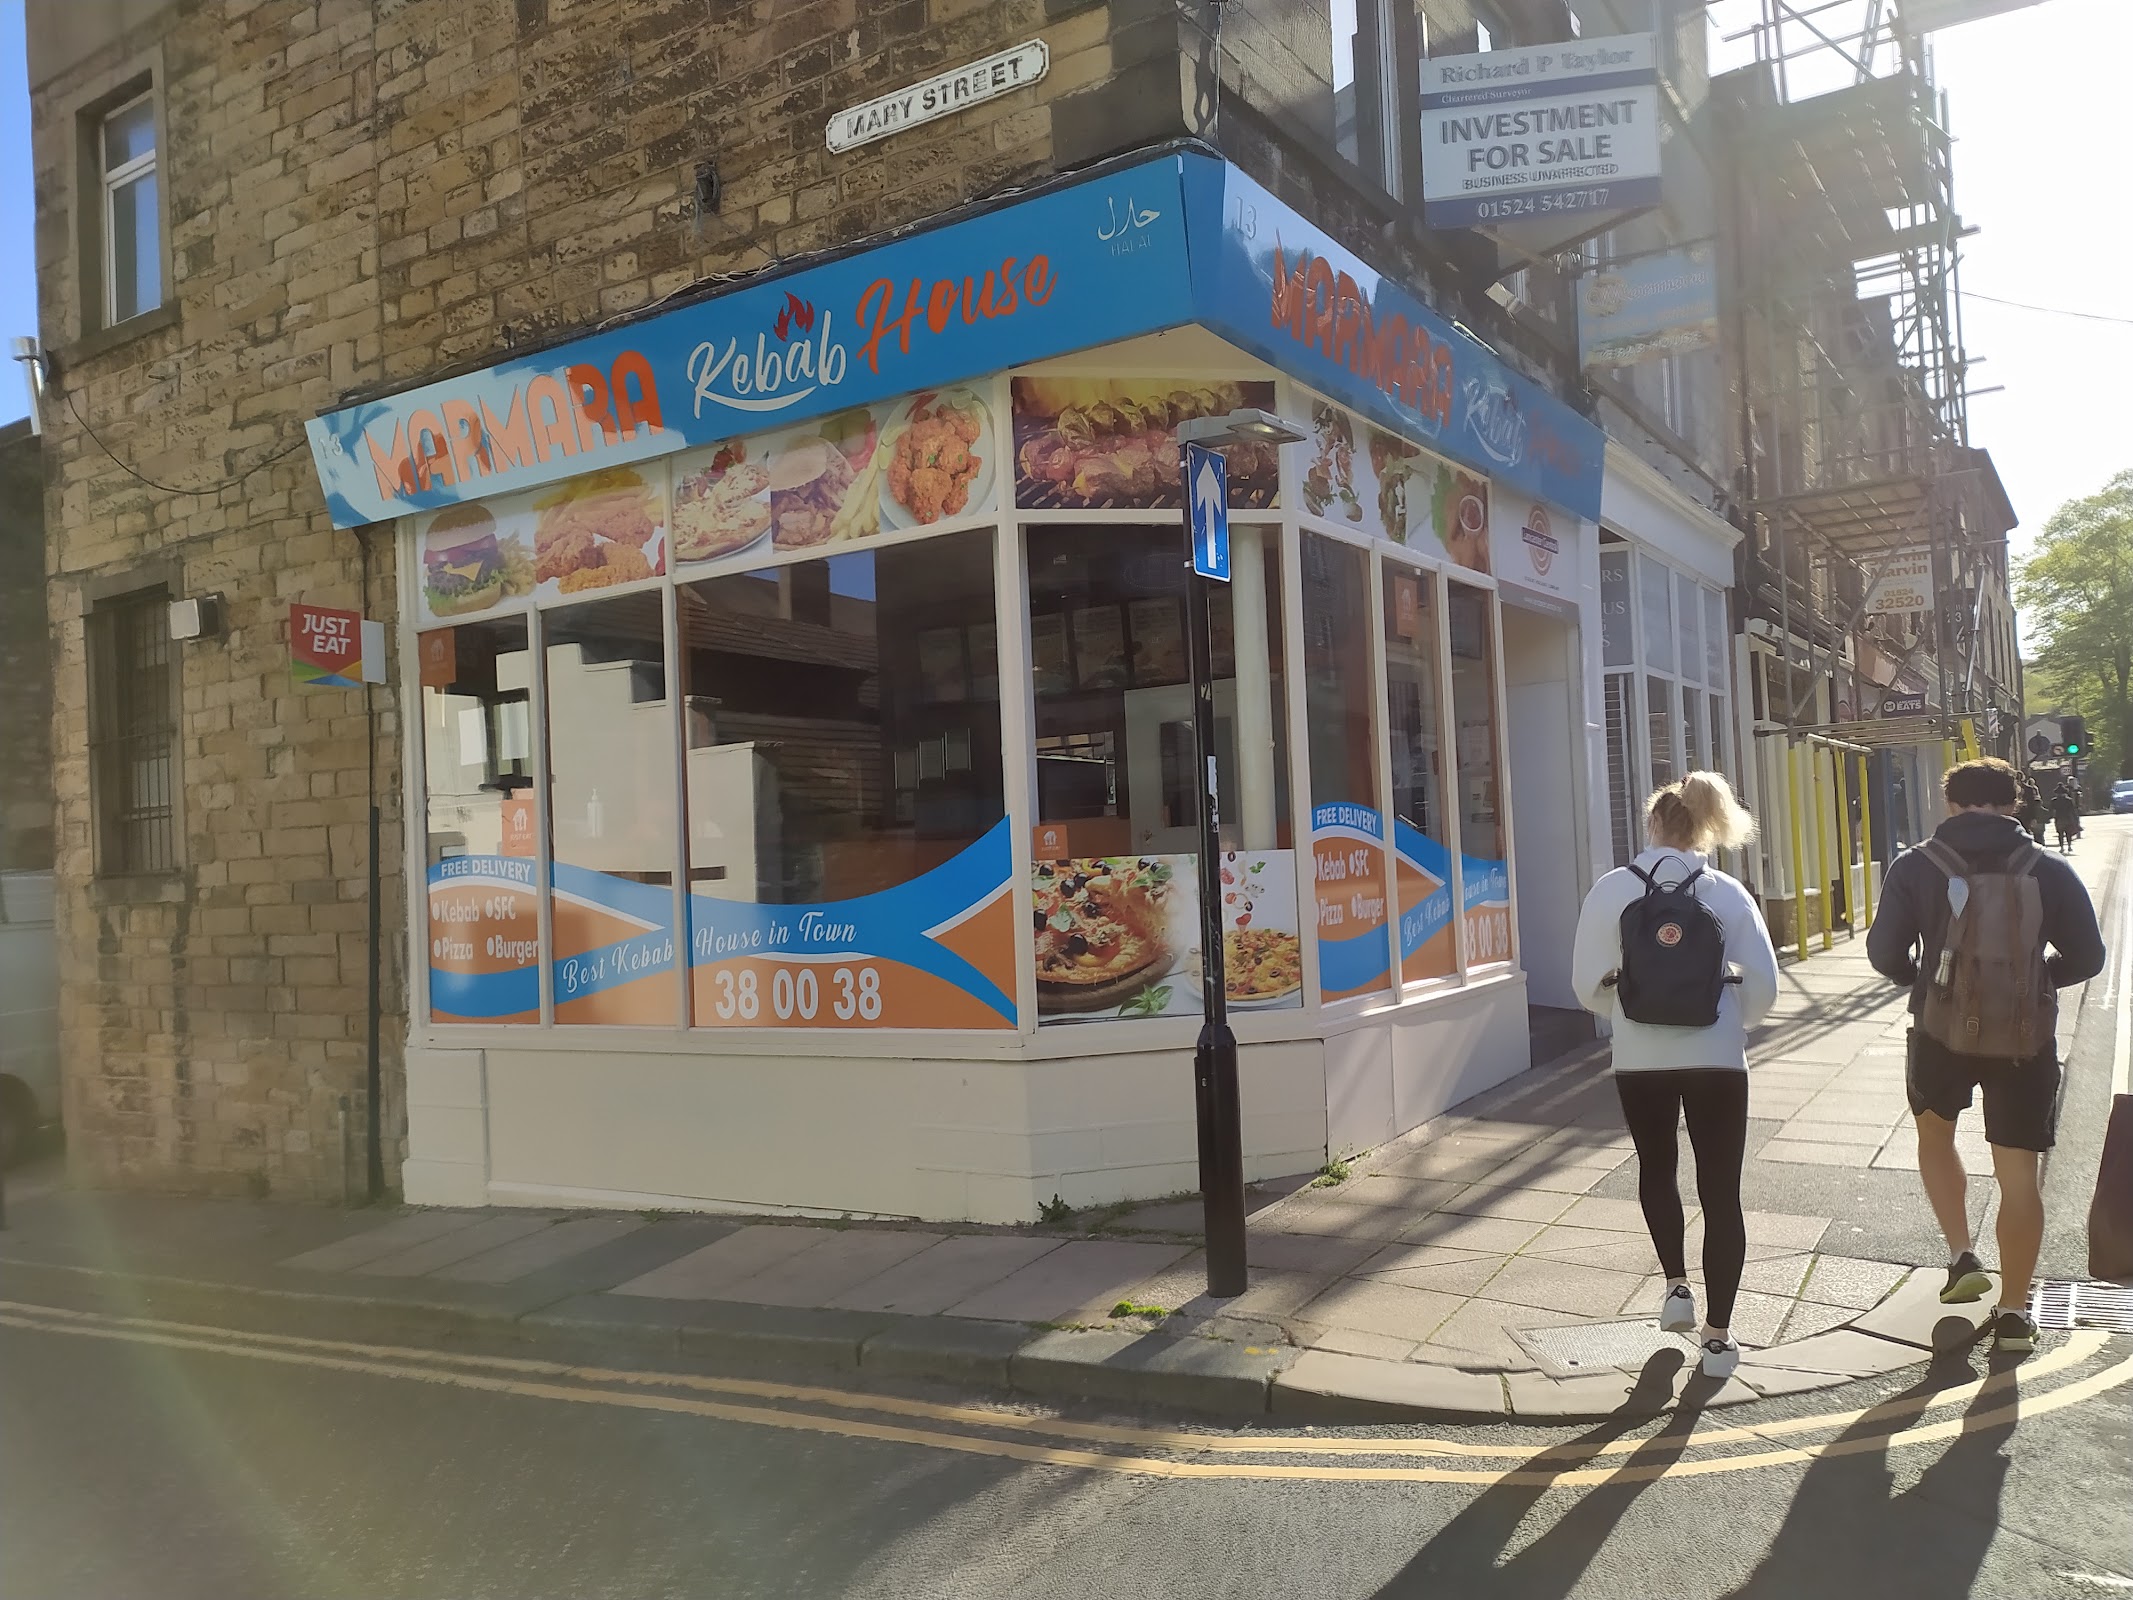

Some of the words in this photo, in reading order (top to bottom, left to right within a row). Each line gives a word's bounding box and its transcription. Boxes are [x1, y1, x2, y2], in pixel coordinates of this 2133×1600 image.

[1441, 57, 1530, 84] Richard
[1536, 56, 1553, 72] P
[1561, 48, 1633, 72] Taylor
[846, 96, 912, 139] MARY
[922, 56, 1022, 111] STREET
[1441, 92, 1487, 104] Chartered
[1490, 87, 1532, 99] Surveyor
[1439, 99, 1637, 144] INVESTMENT
[1467, 143, 1530, 173] FOR
[1538, 134, 1613, 165] SALE
[1462, 172, 1528, 190] BUSINESS
[1529, 163, 1619, 182] UNAFFECTED
[1234, 195, 1257, 241] 13
[1478, 197, 1535, 218] 01524
[1541, 188, 1609, 212] 542717
[1097, 196, 1160, 241] حلال
[1271, 228, 1454, 429] MARMARA
[365, 350, 665, 502] MARMARA
[686, 309, 847, 420] Kebab
[855, 254, 1059, 376] House
[318, 432, 343, 458] 13
[1875, 595, 1925, 611] 32520
[302, 613, 350, 635] JUST
[313, 637, 352, 655] EAT
[1896, 702, 1922, 711] EATS
[1316, 806, 1337, 826] FREE
[1338, 806, 1377, 834] DELIVERY
[441, 860, 468, 877] FREE
[472, 859, 531, 882] DELIVERY
[1317, 851, 1347, 881] Kebab
[1354, 849, 1370, 876] SFC
[1464, 881, 1480, 901] ouse
[441, 898, 480, 923] Kebab
[494, 895, 517, 921] SFC
[1319, 898, 1344, 926] Pizza
[1356, 894, 1384, 925] Burger
[695, 925, 762, 956] House
[768, 920, 790, 945] in
[798, 911, 857, 943] Town
[1403, 915, 1424, 947] Best
[1479, 914, 1492, 958] 00
[1495, 911, 1508, 955] 38
[442, 936, 474, 960] Pizza
[495, 935, 539, 965] Burger
[563, 959, 606, 993] Best
[612, 938, 675, 974] Kebab
[715, 969, 759, 1020] 38
[772, 968, 819, 1020] 00
[832, 967, 882, 1021] 38
